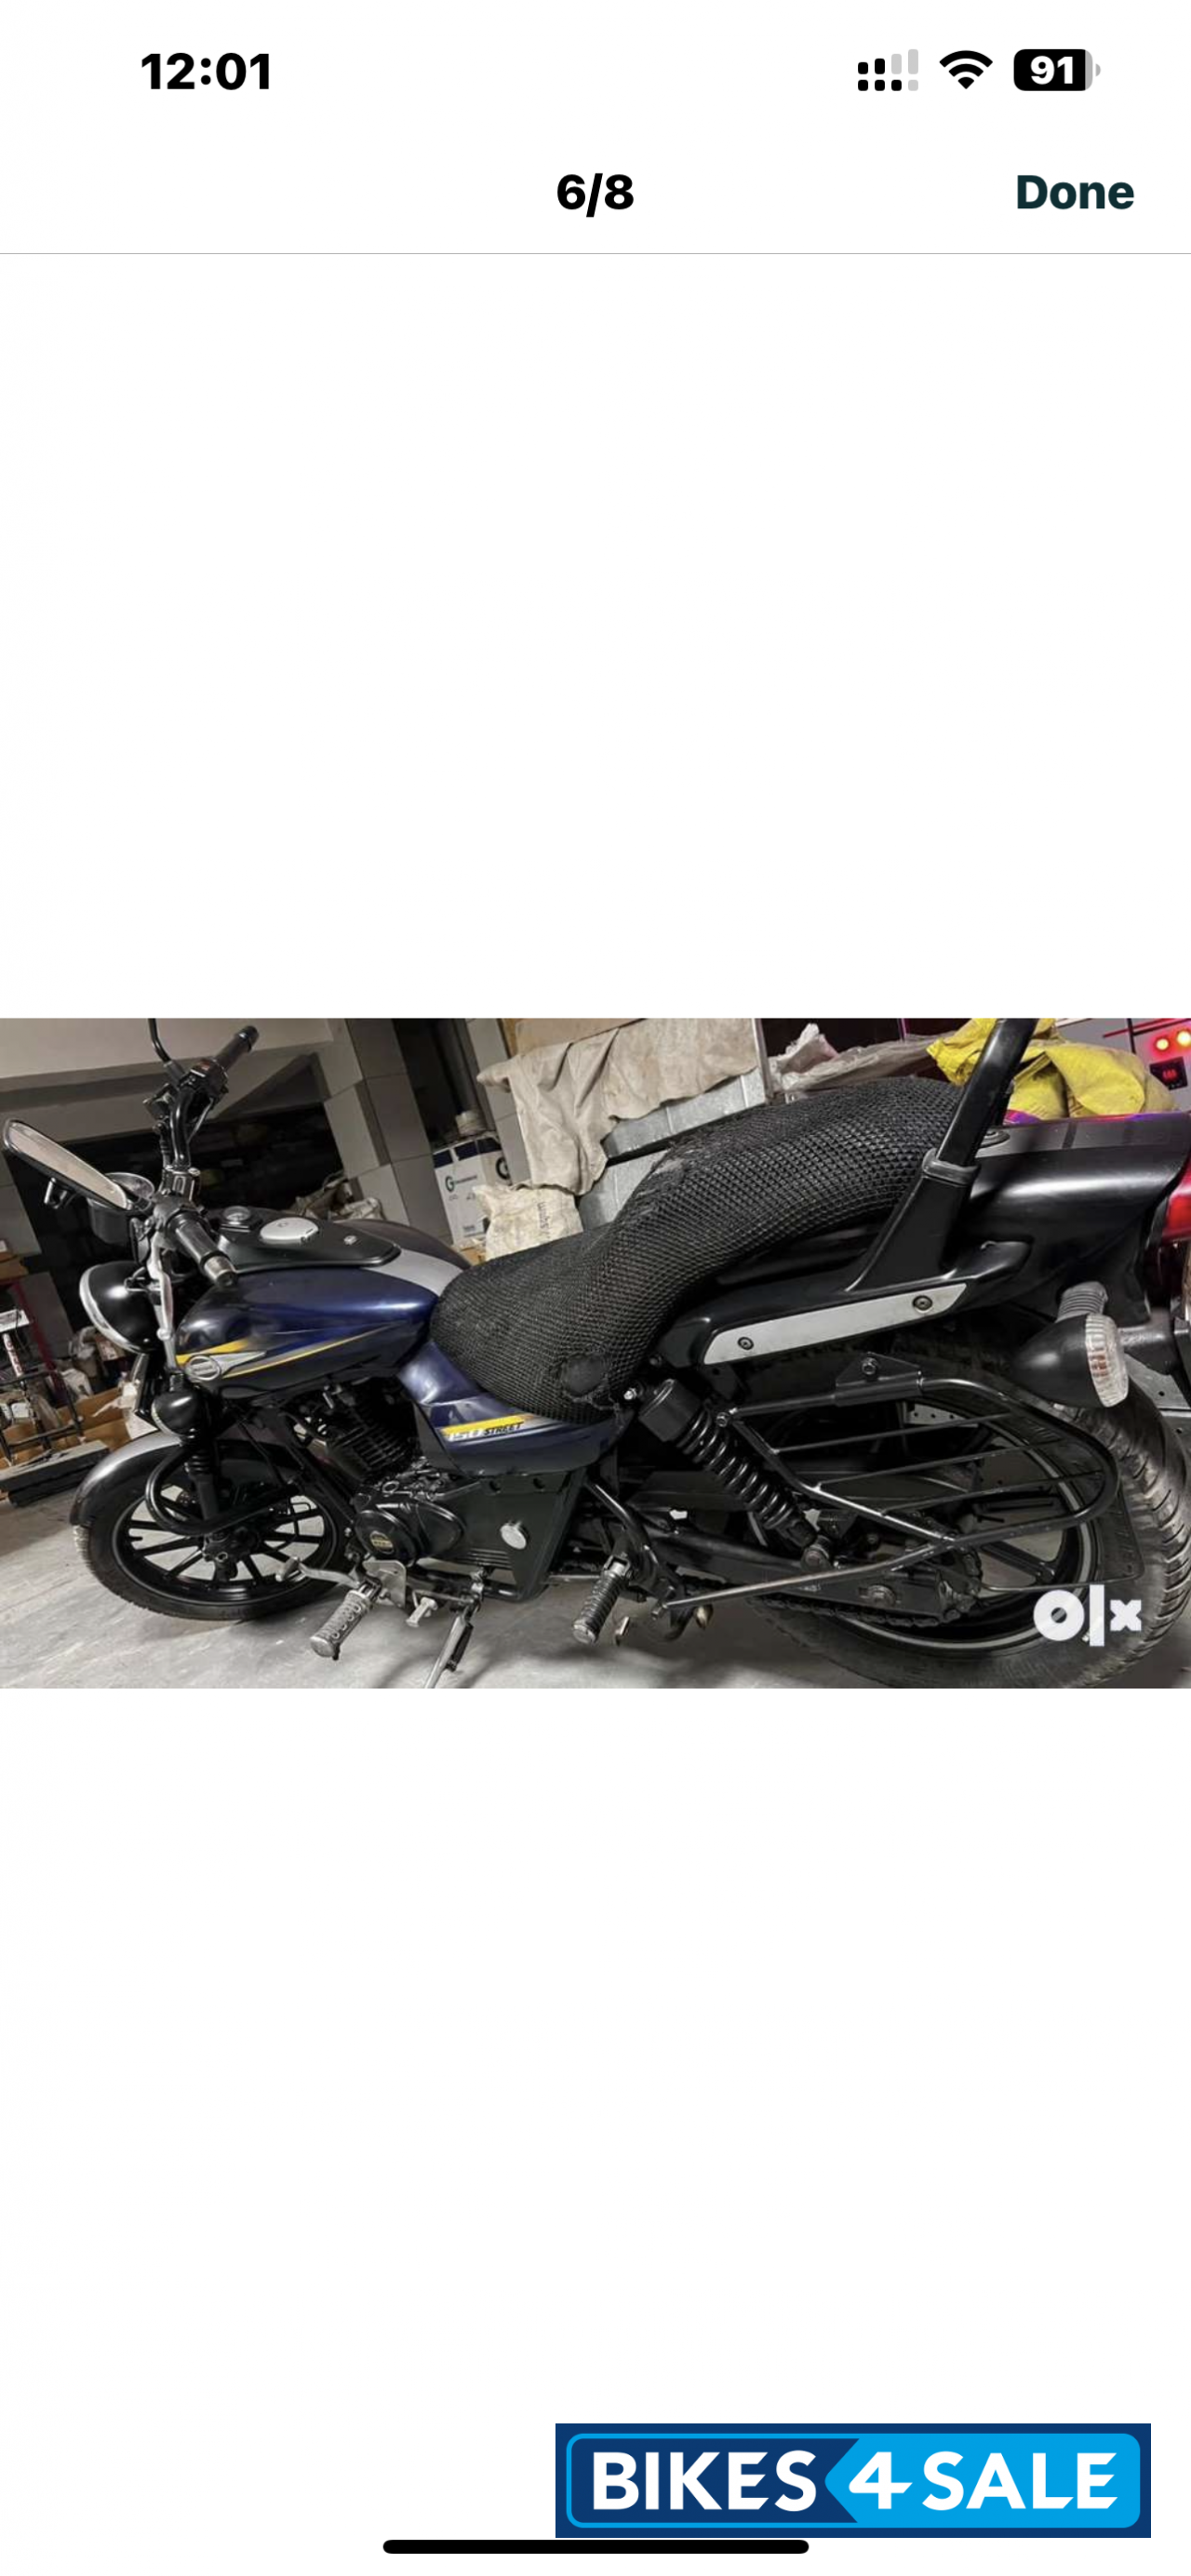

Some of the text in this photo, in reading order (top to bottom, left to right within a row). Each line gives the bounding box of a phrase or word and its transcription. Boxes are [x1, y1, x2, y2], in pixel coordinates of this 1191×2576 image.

[141, 52, 270, 90] 12:01
[1029, 55, 1075, 86] 91
[556, 172, 635, 218] 6/8
[1016, 174, 1134, 210] Done
[484, 1421, 524, 1436] STREET
